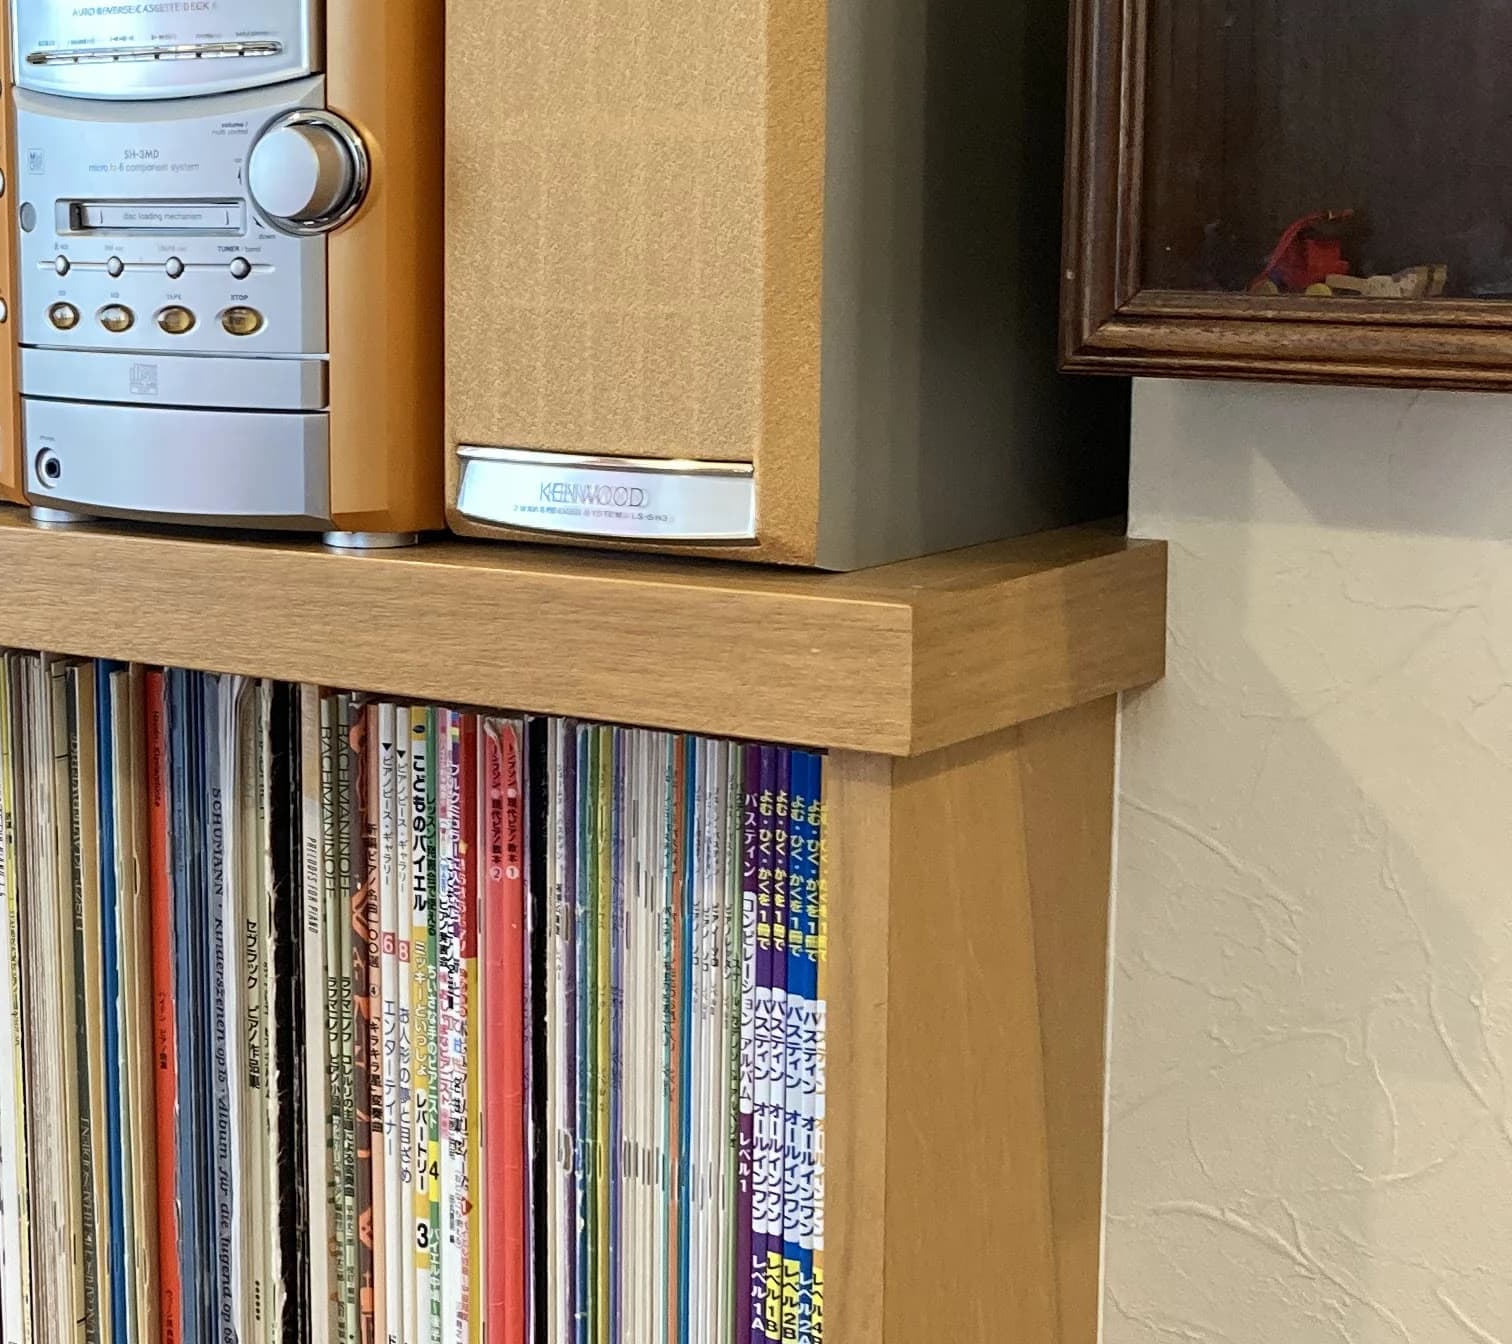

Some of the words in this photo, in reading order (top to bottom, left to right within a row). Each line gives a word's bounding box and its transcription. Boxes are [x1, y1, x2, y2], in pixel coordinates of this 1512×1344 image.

[538, 481, 650, 507] KENWOOD
[211, 788, 225, 896] SCHUMANN
[320, 726, 336, 898] RACHMANINOFF
[337, 723, 351, 898] RACHMANINOFF
[412, 755, 426, 912] こどものバイエル
[743, 793, 758, 878] バスティン
[306, 836, 319, 884] PRELUDES
[308, 884, 318, 904] FOR
[308, 905, 319, 934] PIANO
[383, 936, 394, 954] 6
[399, 941, 410, 962] 8
[384, 1000, 396, 1156] エンターテイナー
[754, 1000, 771, 1081] バスティン
[770, 1001, 787, 1081] バスティン
[787, 1007, 804, 1089] バスティン
[802, 1012, 819, 1095] バスティン
[217, 1097, 231, 1160] Album
[416, 1091, 428, 1191] レパートリー
[739, 1132, 751, 1193] レベル1
[753, 1103, 769, 1221] オールインワン
[768, 1104, 784, 1222] オールインワン
[429, 1160, 439, 1181] 4
[784, 1109, 801, 1230] オールインワン
[800, 1115, 816, 1237] オールインワン
[417, 1223, 429, 1249] 3
[751, 1254, 766, 1331] レベル1A
[766, 1258, 780, 1333] レベル1B
[783, 1264, 800, 1340] レベル2B
